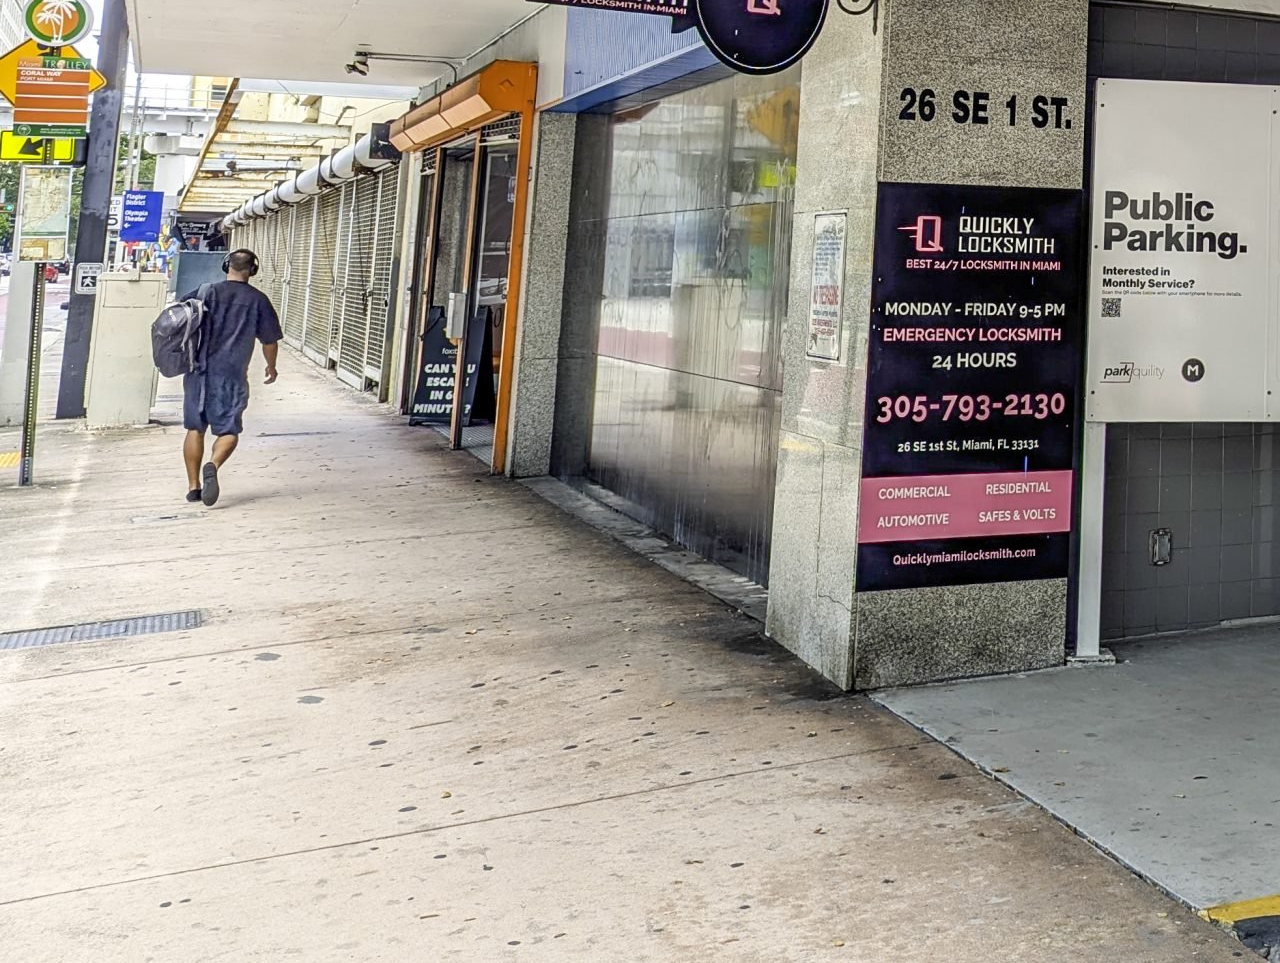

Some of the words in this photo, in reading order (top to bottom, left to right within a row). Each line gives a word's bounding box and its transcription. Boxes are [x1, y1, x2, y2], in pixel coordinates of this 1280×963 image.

[643, 3, 655, 12] IN
[656, 5, 687, 15] MIAMI
[899, 87, 936, 122] 26
[952, 89, 990, 125] SE
[1006, 95, 1017, 126] 1
[1031, 95, 1072, 129] ST.
[1103, 189, 1215, 222] Public
[959, 216, 1035, 235] QUICKLY
[958, 236, 1055, 254] LOCKSMITH
[1102, 221, 1248, 260] Parking.
[906, 259, 932, 269] BEST
[934, 259, 958, 272] 24/7
[961, 260, 1018, 270] LOCKSMITH
[1019, 260, 1031, 270] IN
[1032, 261, 1061, 271] MIAMI
[1102, 266, 1159, 276] Interested
[1160, 266, 1171, 276] in
[1102, 278, 1146, 289] Monthly
[1147, 279, 1195, 288] Service?
[885, 302, 952, 317] MONDAY
[964, 303, 1017, 317] FRIDAY
[1019, 305, 1042, 319] 9-5
[1044, 303, 1066, 316] PM
[883, 327, 976, 343] EMERGENCY
[978, 328, 1061, 342] LOCKSMITH
[425, 364, 450, 373] CAN
[452, 364, 476, 373] YU
[932, 356, 952, 371] 24
[956, 352, 1017, 369] HOURS
[430, 391, 444, 400] IN
[876, 392, 1066, 424] 305-793-2130
[897, 442, 911, 453] 26
[912, 442, 927, 452] SE
[928, 442, 944, 451] 1st
[946, 440, 960, 453] St,
[962, 439, 995, 452] Miami,
[997, 439, 1010, 450] FL
[1011, 439, 1039, 451] 33131
[878, 486, 951, 500] COMMERCIAL
[985, 482, 1052, 495] RESIDENTIAL
[877, 514, 949, 528] AUTOMOTIVE
[978, 510, 1011, 523] SAFES
[1013, 510, 1020, 521] &
[1023, 508, 1056, 521] VOLTS
[892, 548, 1036, 566] Quicklymiamilocksmith.com
